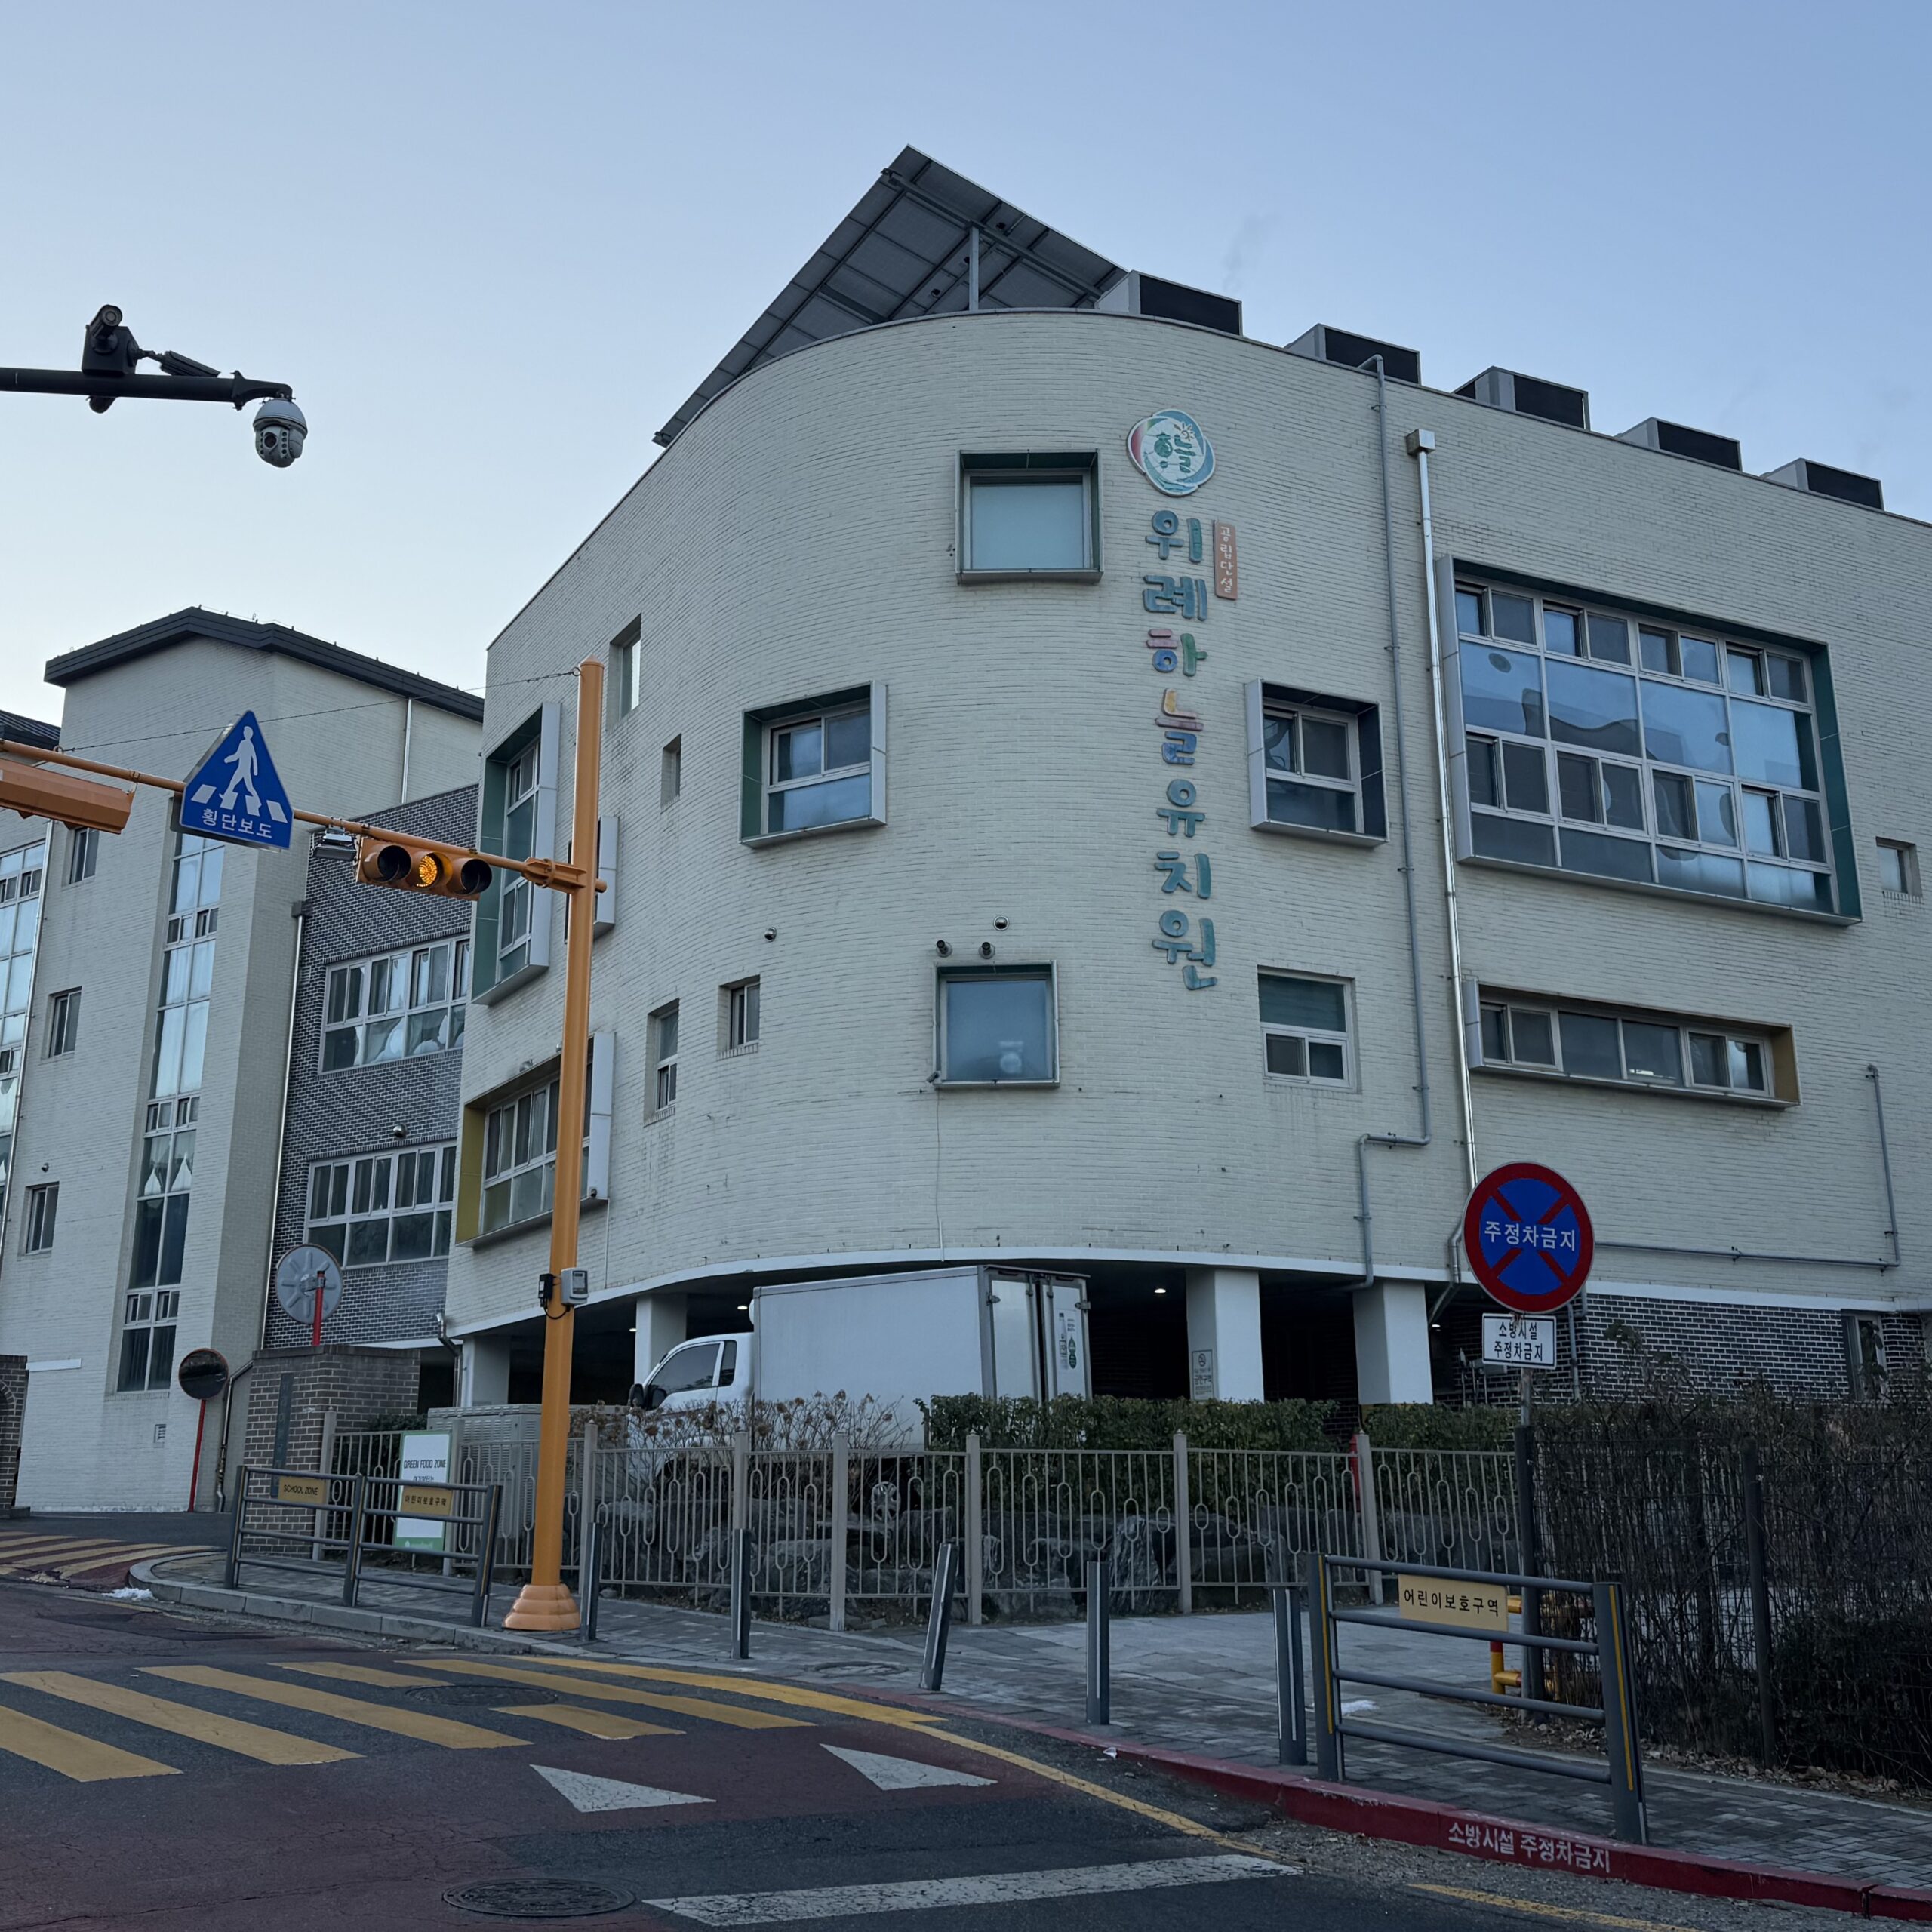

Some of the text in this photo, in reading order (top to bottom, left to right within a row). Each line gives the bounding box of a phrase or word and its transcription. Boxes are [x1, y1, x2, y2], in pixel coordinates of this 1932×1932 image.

[1220, 525, 1235, 593] 공립단설
[1142, 509, 1218, 991] 위례하늘유치원
[202, 808, 272, 838] 횡단보도
[1484, 1220, 1576, 1252] 주정차금지
[1498, 1321, 1538, 1340] 소방시설
[1494, 1340, 1543, 1362] 주정차금지
[403, 1459, 447, 1469] GREEN FOOD ZONE
[283, 1484, 318, 1496] SCHOOL ZONE
[405, 1494, 447, 1506] 어린이보호구역
[1404, 1589, 1499, 1617] 어린이보호구역
[1447, 1822, 1611, 1873] 소방시설 주정차금지
